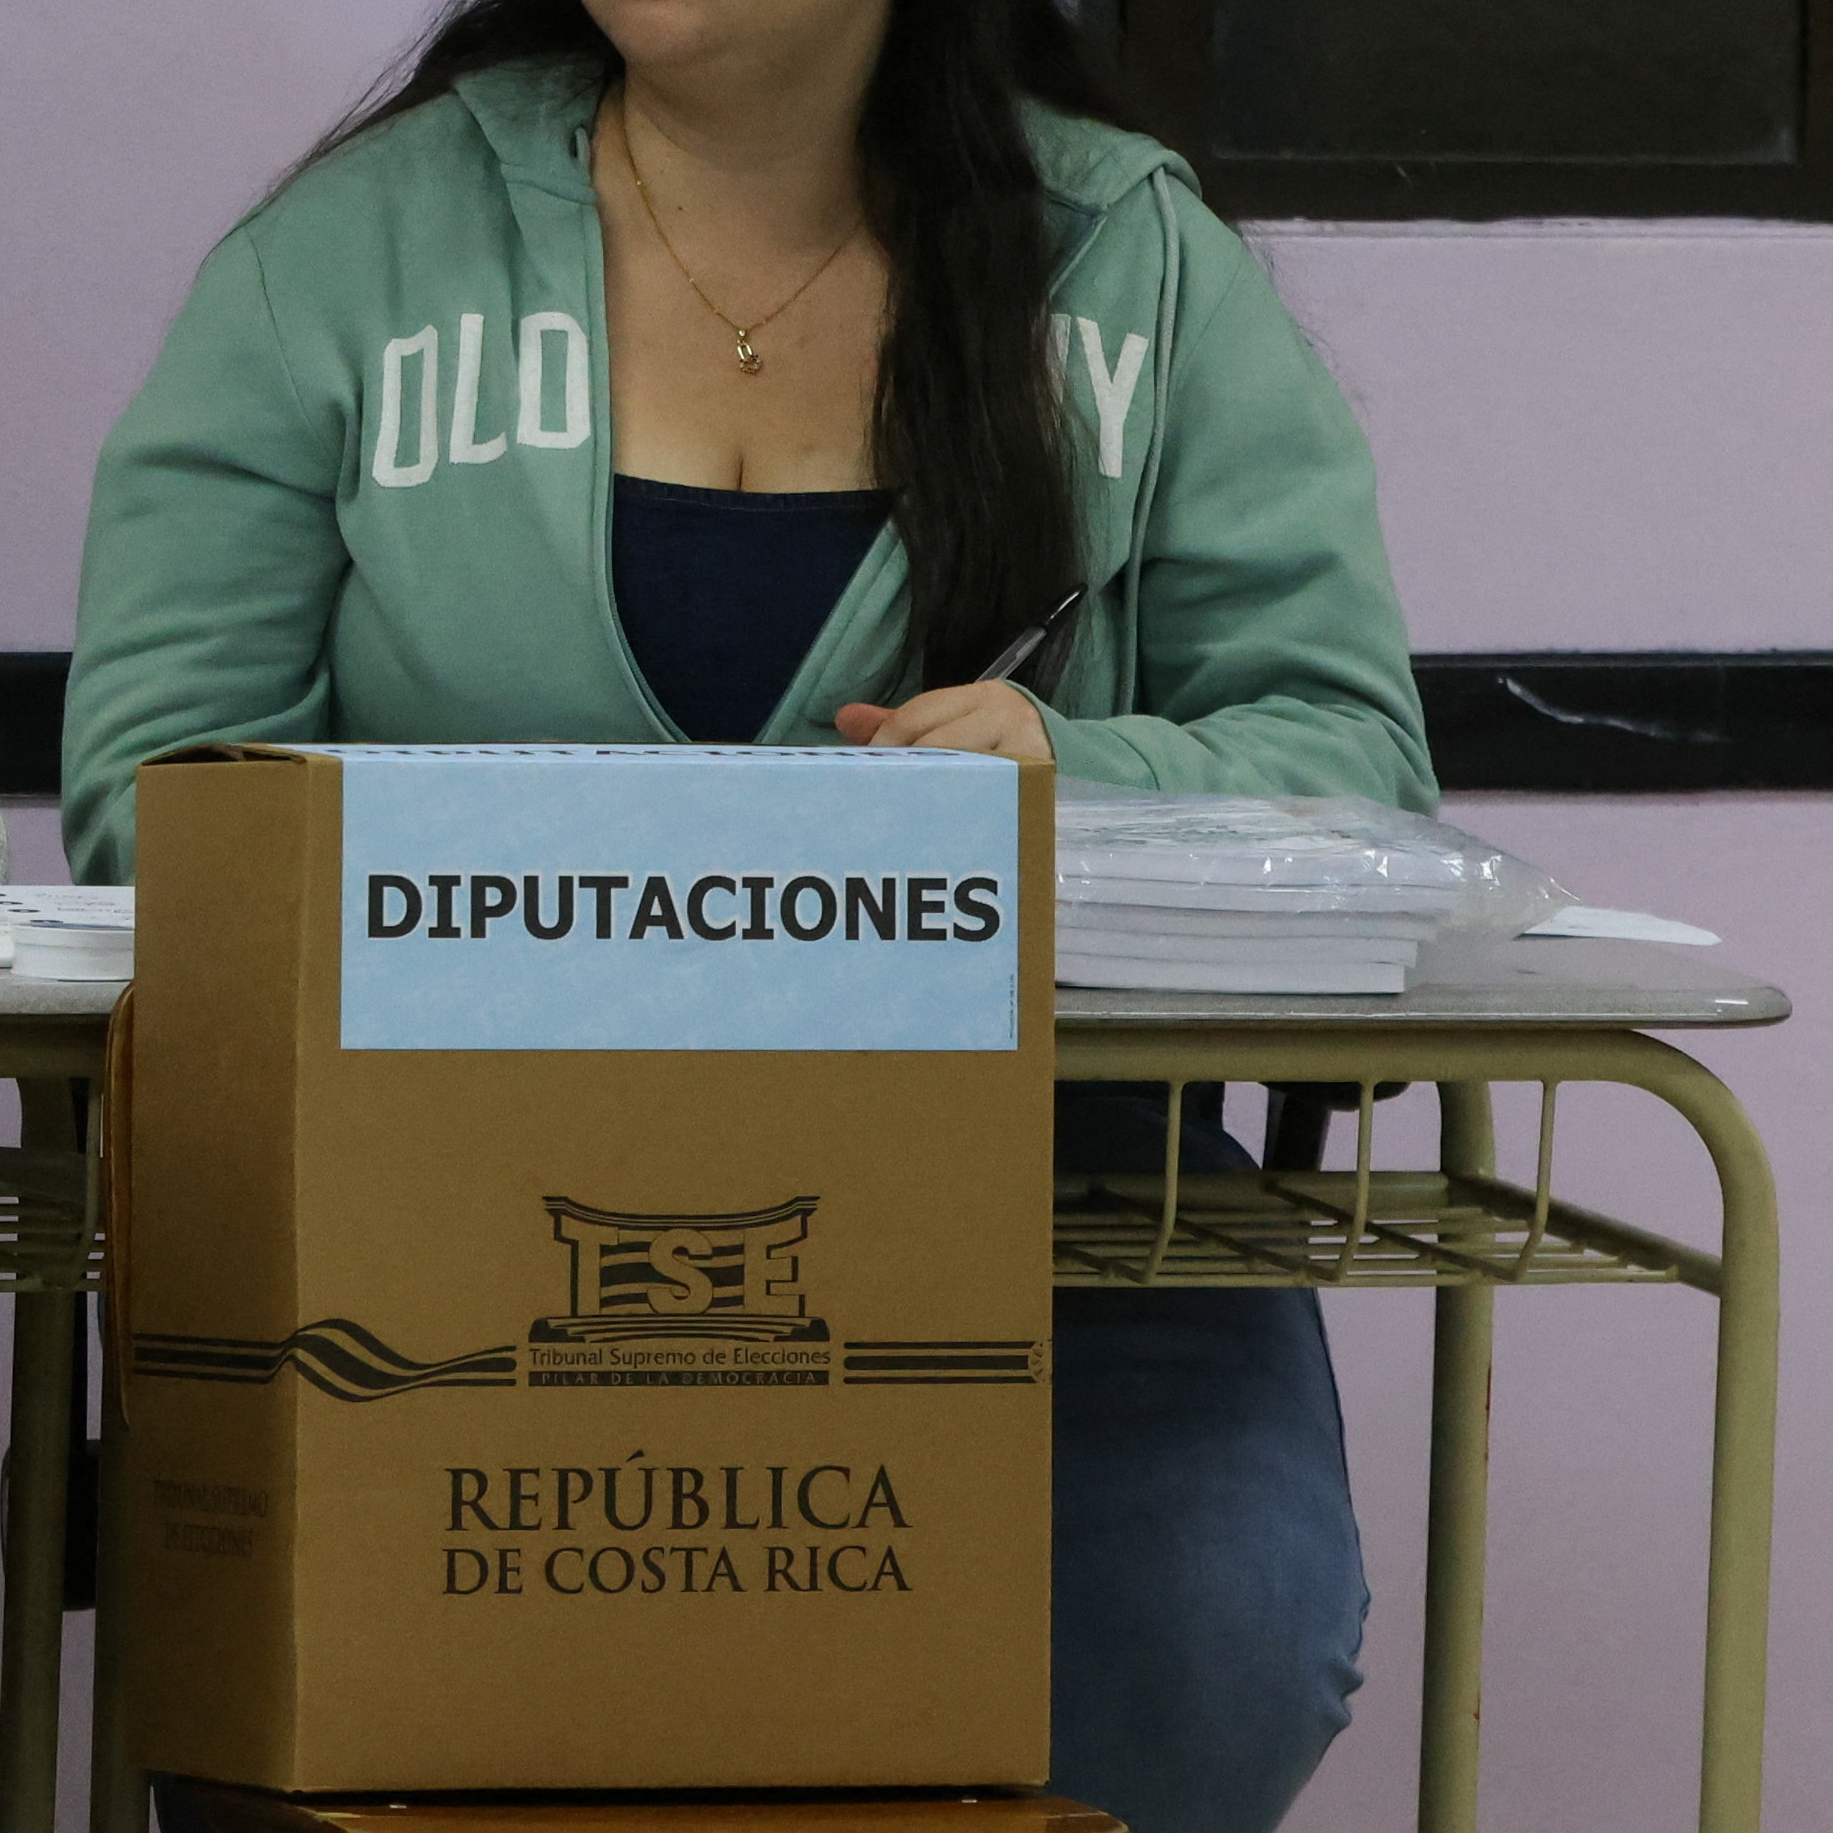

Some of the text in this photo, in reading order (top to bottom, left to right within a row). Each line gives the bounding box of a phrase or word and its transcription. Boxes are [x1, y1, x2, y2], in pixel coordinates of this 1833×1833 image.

[370, 311, 592, 489] OLD
[366, 873, 1001, 943] DIPUTACIONES
[552, 1212, 810, 1316] TSE
[529, 1347, 832, 1370] Tribunal Supremo de Elecciones
[541, 1371, 816, 1386] PILAR DE LA DEMOCRACIA
[443, 1448, 915, 1532] REPÚBLICA
[440, 1544, 915, 1596] DE COSTA RICA
